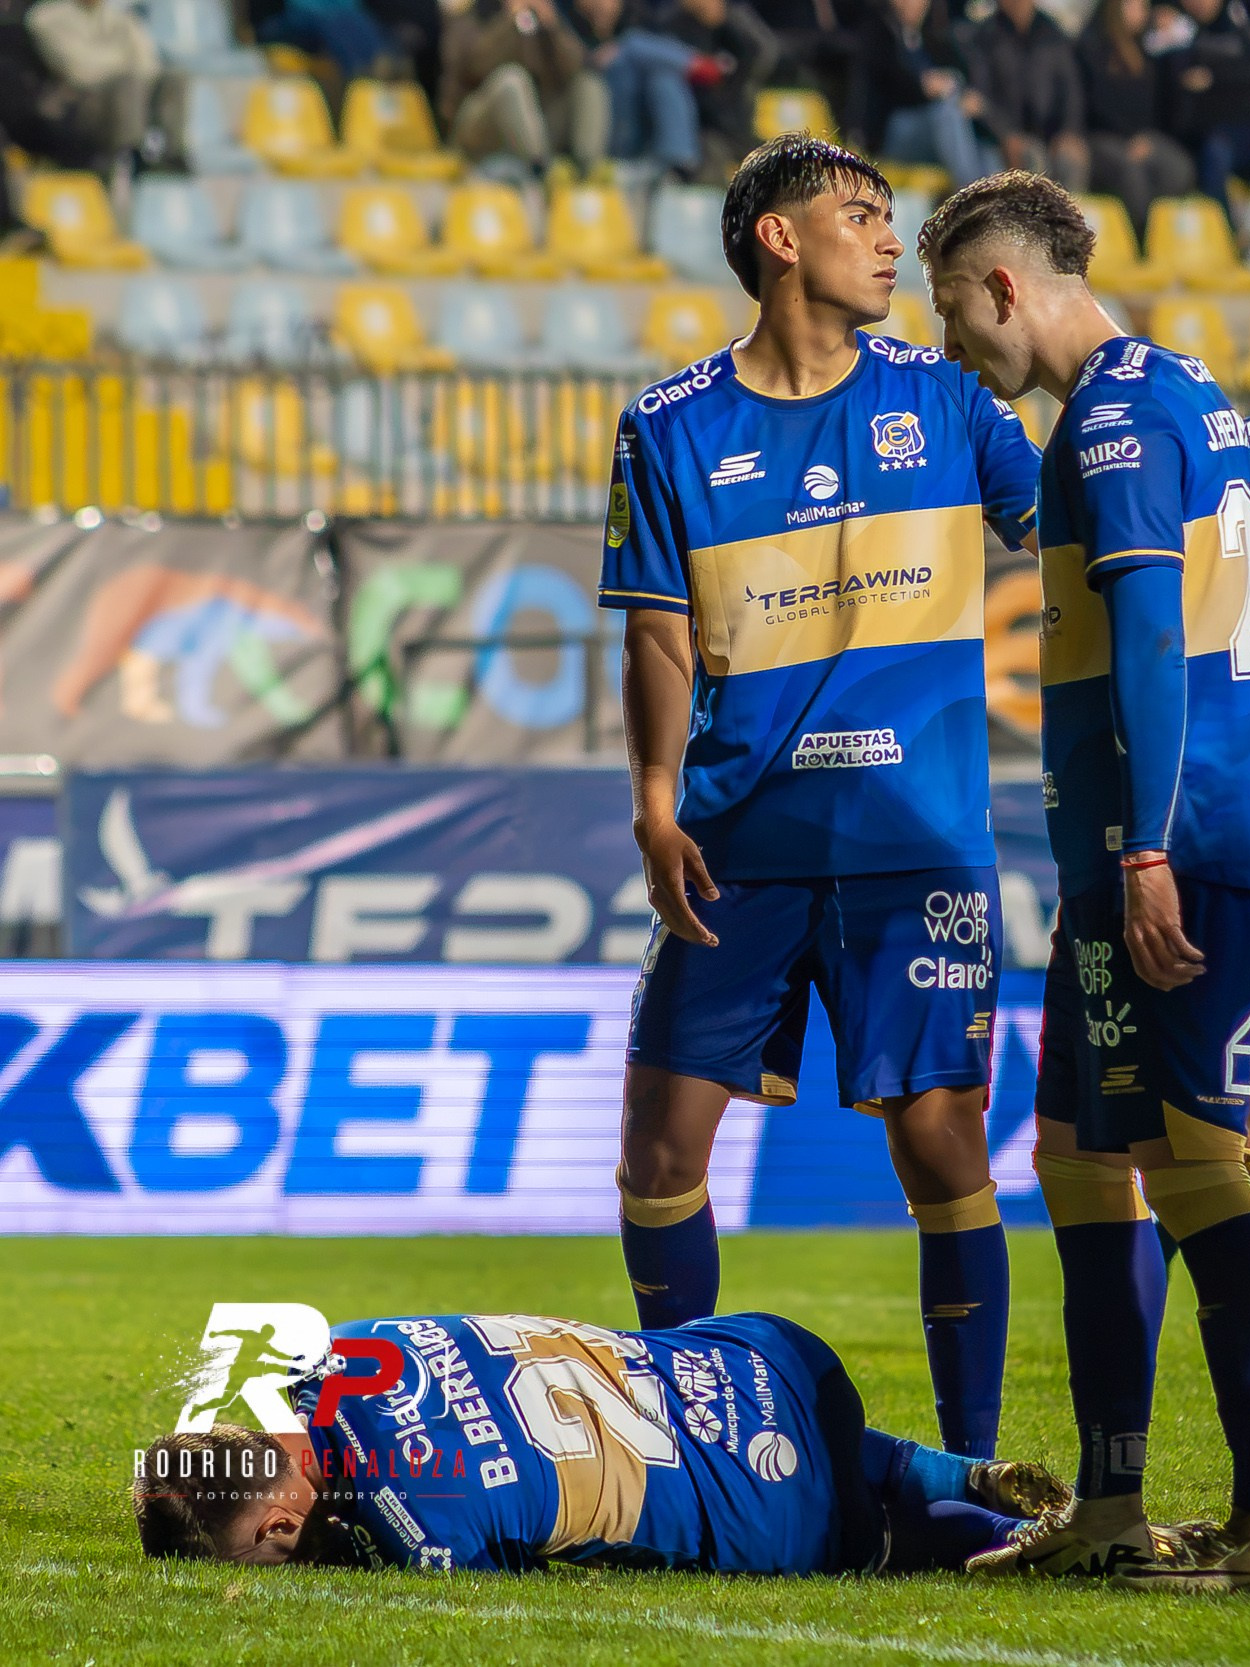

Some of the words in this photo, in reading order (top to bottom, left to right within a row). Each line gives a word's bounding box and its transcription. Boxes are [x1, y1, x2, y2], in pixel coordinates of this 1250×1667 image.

[869, 337, 940, 366] Claro
[638, 370, 713, 415] Claro
[1081, 420, 1134, 434] SKECHERS
[710, 468, 766, 487] SKECHERS
[786, 501, 866, 526] MallMarina
[759, 566, 933, 611] TERRAWIND
[765, 605, 830, 626] GLOBAL
[838, 588, 931, 610] PROTECTION
[801, 730, 894, 752] APUESTAS
[795, 747, 900, 769] ROYAL.COM
[908, 957, 988, 989] Claro
[721, 1385, 735, 1401] de
